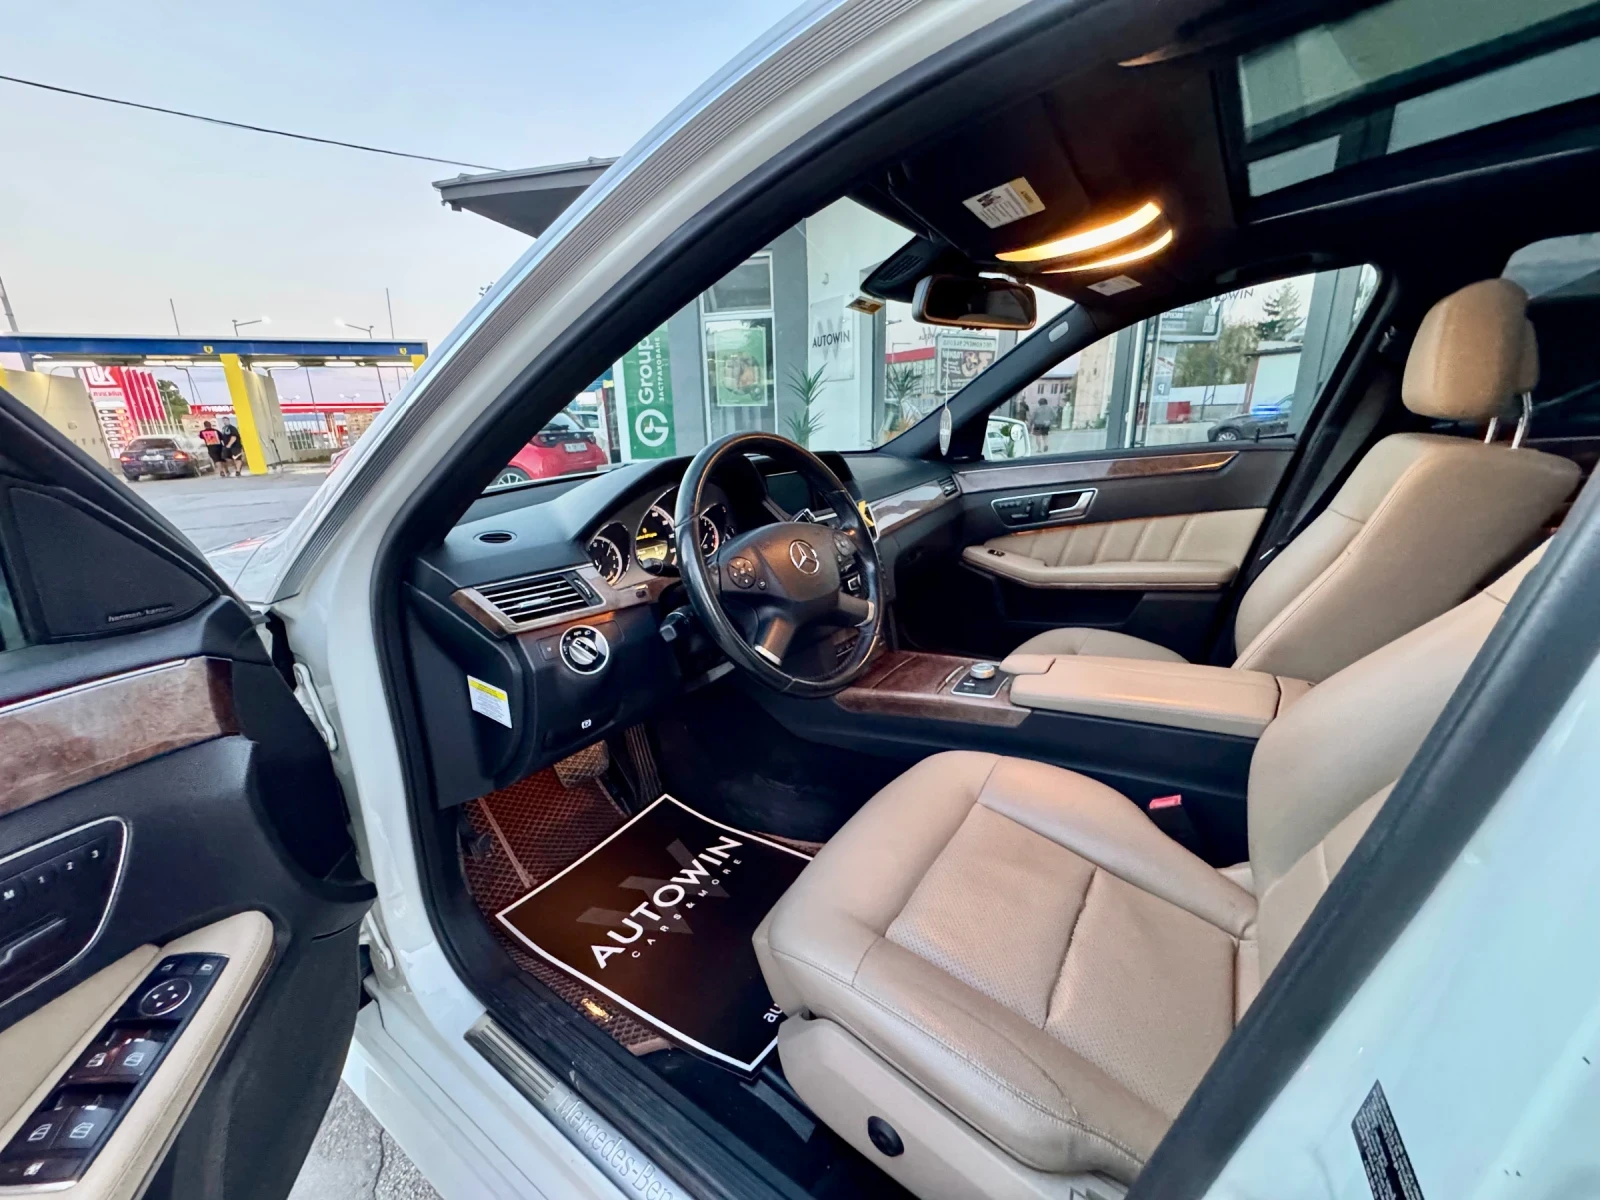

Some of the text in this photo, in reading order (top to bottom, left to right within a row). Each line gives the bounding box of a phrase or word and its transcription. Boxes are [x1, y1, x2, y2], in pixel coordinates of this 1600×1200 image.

[812, 330, 850, 349] AUTOWIN
[591, 836, 743, 968] AUTOWIN
[631, 858, 743, 959] CARS & MORE
